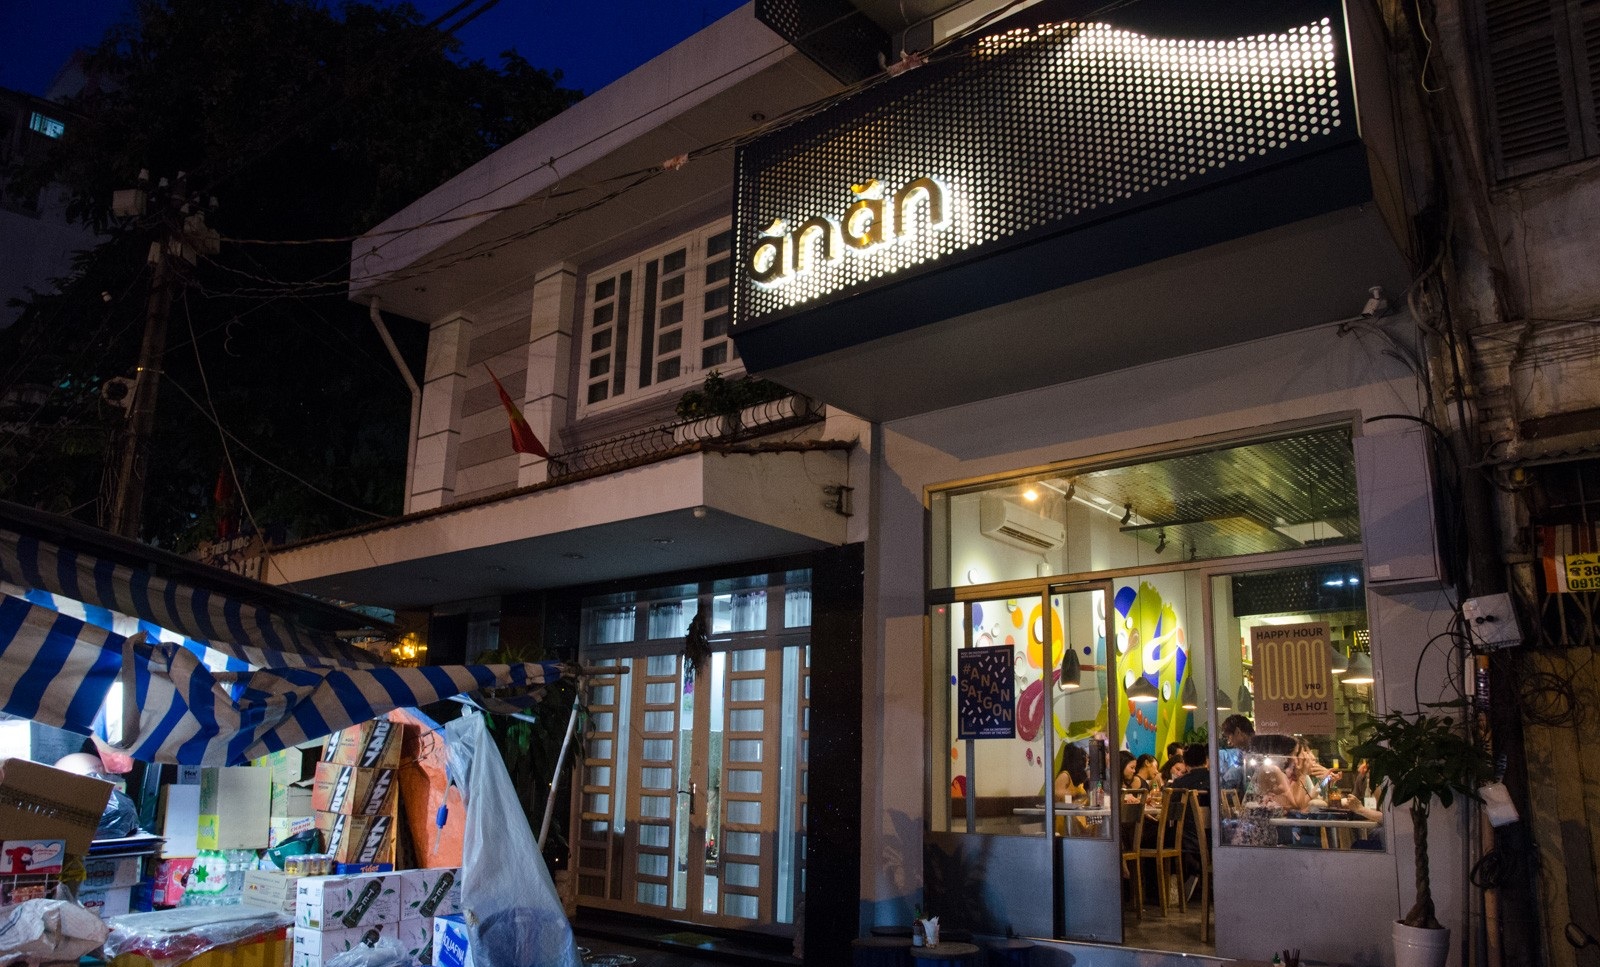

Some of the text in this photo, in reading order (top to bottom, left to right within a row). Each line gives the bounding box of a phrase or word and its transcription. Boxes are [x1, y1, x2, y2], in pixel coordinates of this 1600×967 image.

[1256, 627, 1323, 640] HAPPY HOUR
[1257, 639, 1328, 700] 10.000
[1283, 702, 1303, 712] BIA
[325, 729, 341, 762] 47
[363, 721, 390, 768] 247
[355, 888, 375, 913] TEA
[431, 880, 448, 903] TEA
